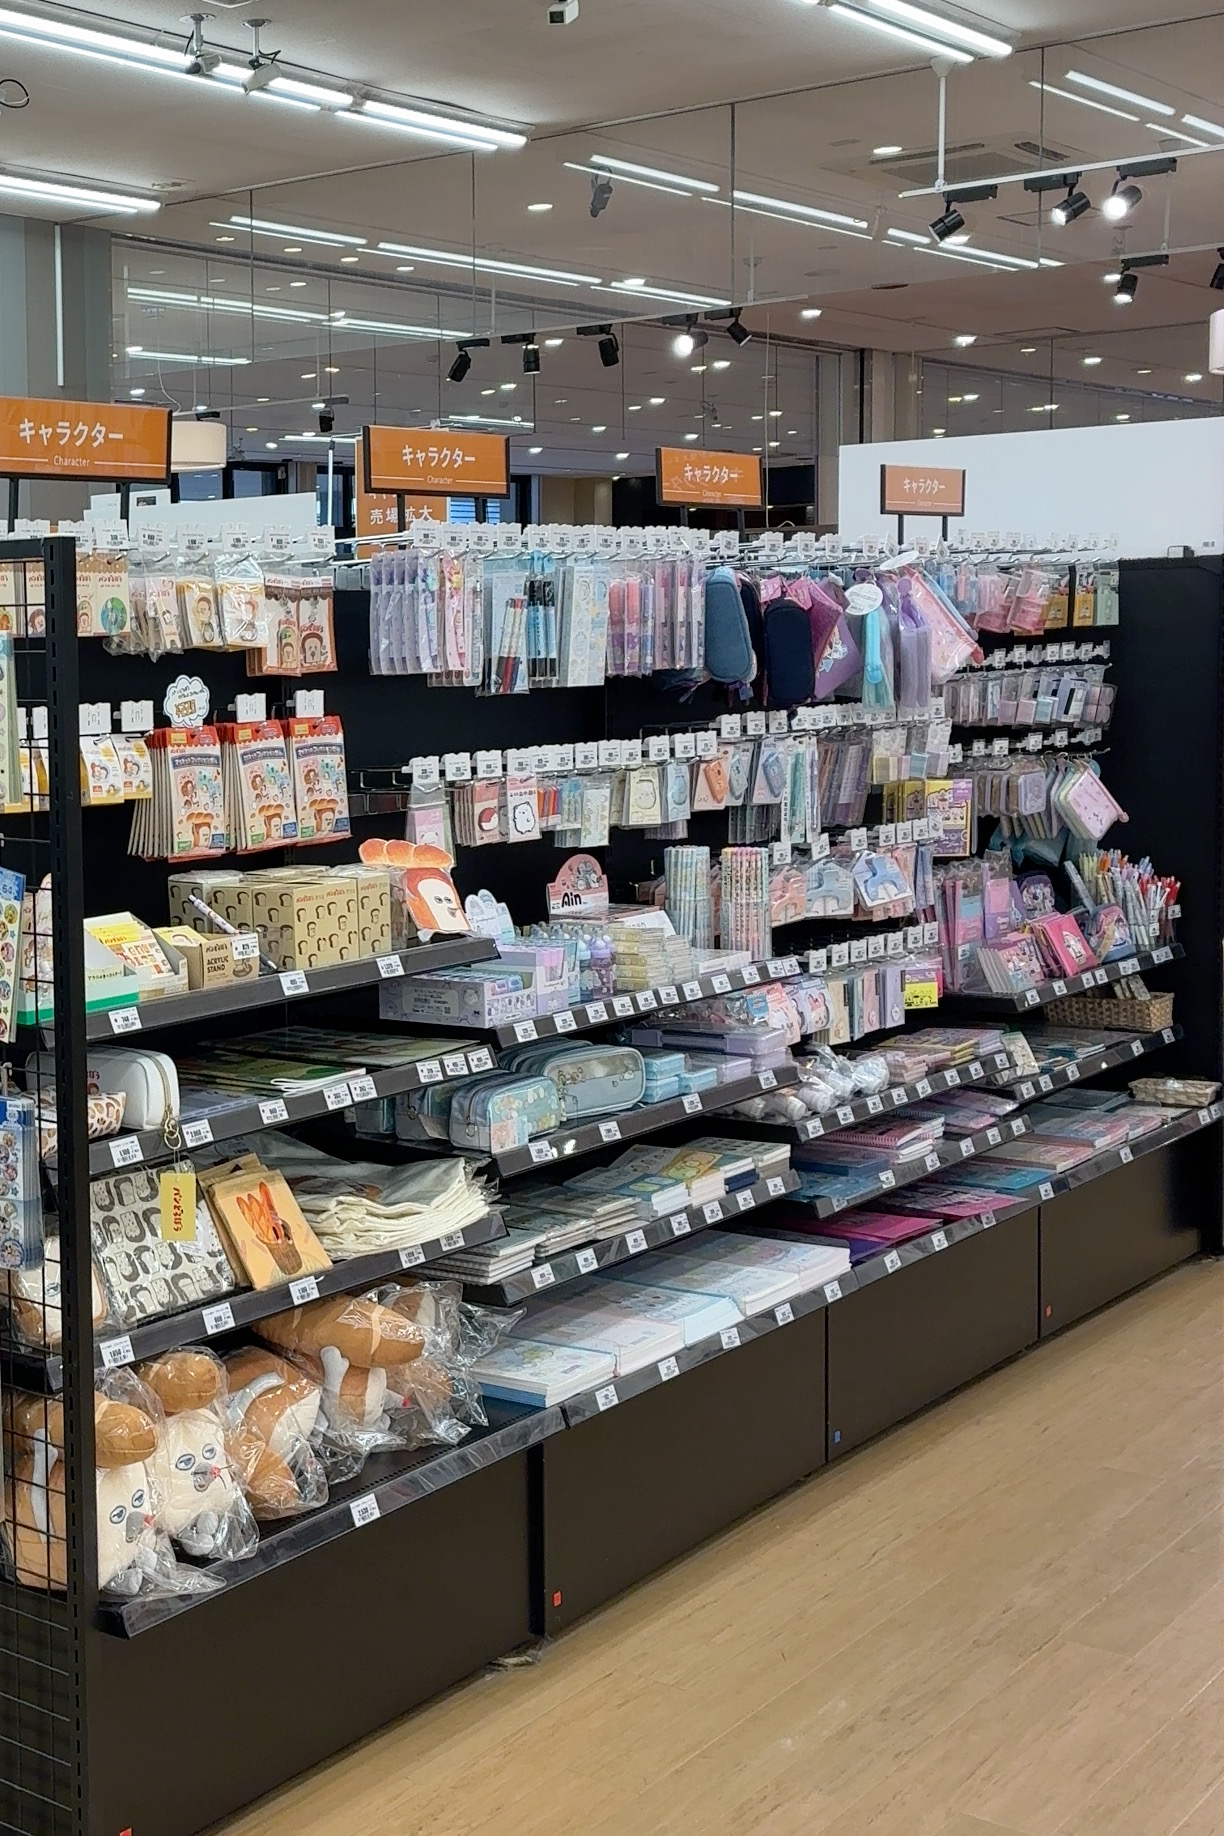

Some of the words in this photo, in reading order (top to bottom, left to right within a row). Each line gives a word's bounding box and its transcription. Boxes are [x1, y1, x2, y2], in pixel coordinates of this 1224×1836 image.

[19, 418, 123, 448] キャラクター
[53, 455, 90, 467] Character
[402, 445, 475, 468] キャラクター
[427, 475, 453, 484] Character
[684, 463, 738, 484] キャラクター
[903, 478, 945, 494] キャラクター
[370, 505, 433, 525] 売場拡大
[561, 892, 582, 908] Ain
[206, 955, 229, 966] ACRYLIC
[207, 964, 226, 973] STAND
